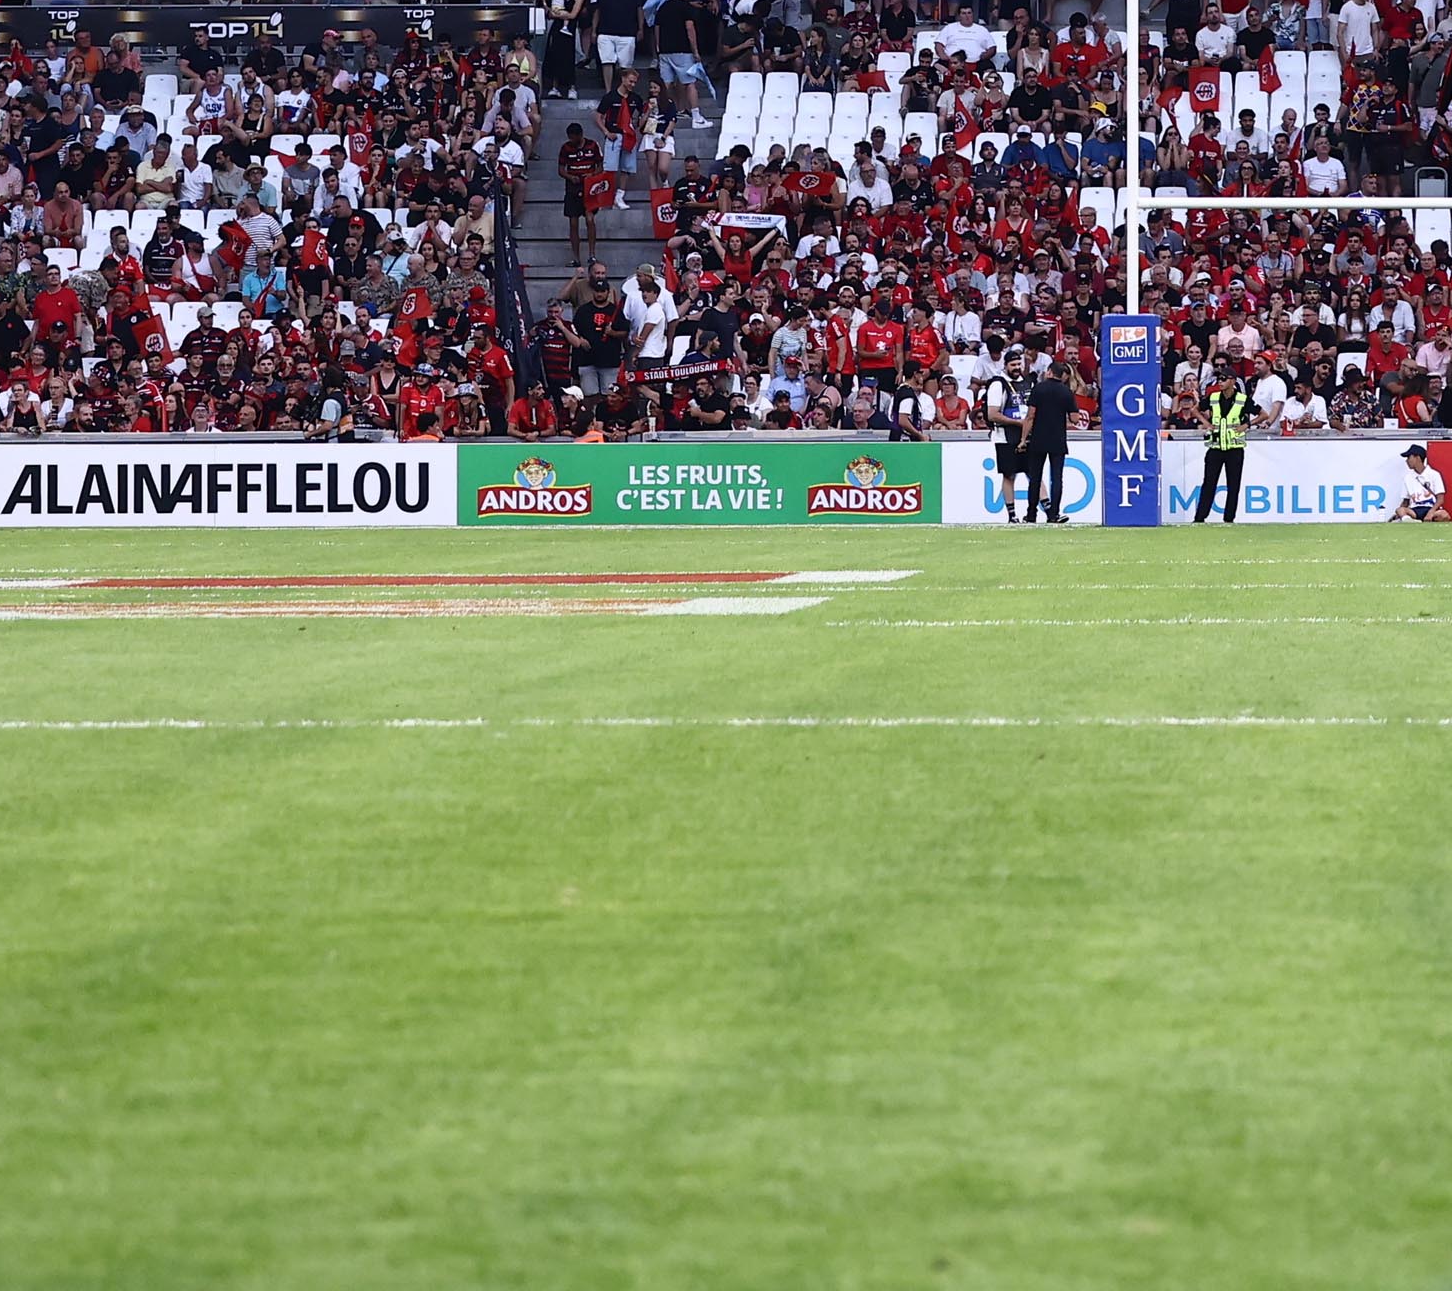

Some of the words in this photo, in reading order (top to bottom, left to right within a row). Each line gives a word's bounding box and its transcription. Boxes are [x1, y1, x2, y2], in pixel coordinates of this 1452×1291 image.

[48, 10, 80, 20] TOP
[403, 9, 435, 19] TOP
[1114, 345, 1145, 359] GMF
[644, 369, 669, 381] STADE
[669, 362, 719, 379] TOULOUSAIN
[629, 465, 671, 485] LES
[675, 464, 768, 488] FRUITS,
[479, 488, 589, 513] ANDROS
[616, 489, 686, 510] C'EST
[691, 489, 723, 510] LA
[728, 489, 771, 510] VIE
[810, 488, 918, 512] ANDROS
